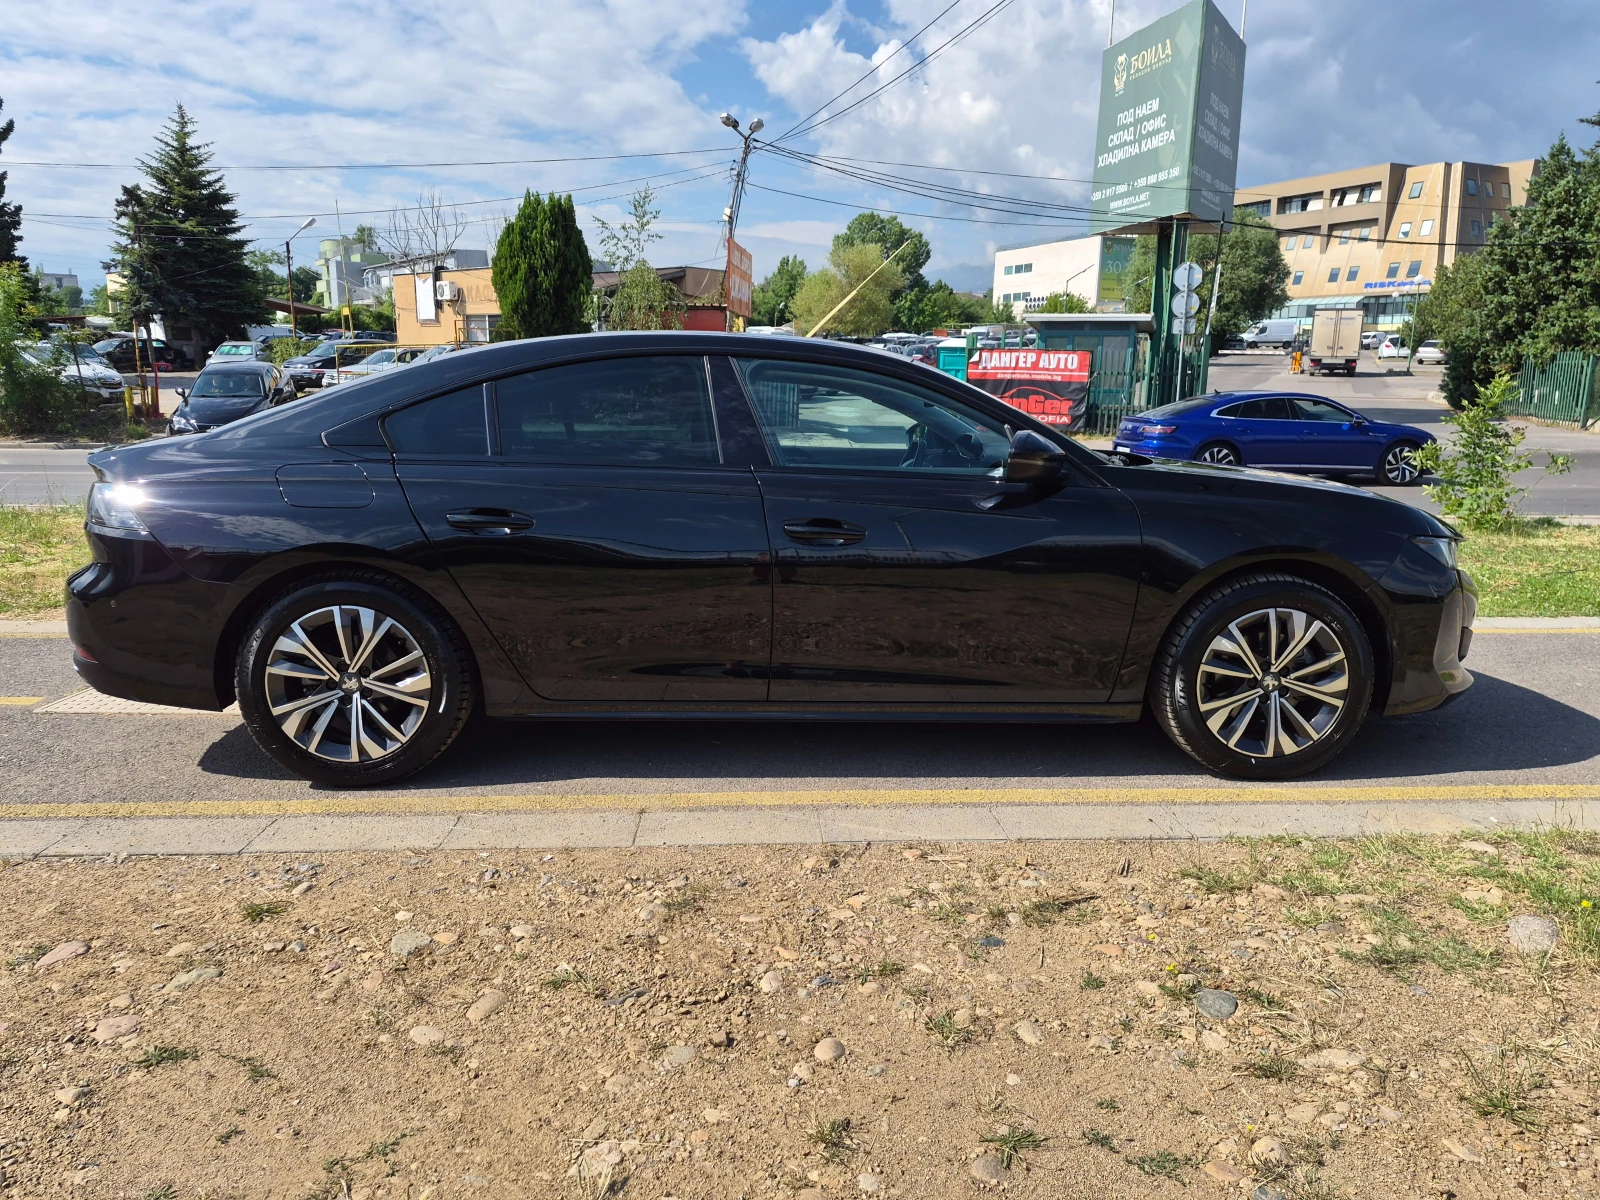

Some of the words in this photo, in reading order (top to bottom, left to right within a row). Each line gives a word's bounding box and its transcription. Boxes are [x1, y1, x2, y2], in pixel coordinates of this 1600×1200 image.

[1130, 38, 1172, 74] БОИЛА
[1117, 108, 1134, 126] ПОД
[1135, 97, 1160, 119] НАЕМ
[1108, 126, 1134, 148] СКЛАД
[1135, 124, 1141, 139] /
[1141, 113, 1167, 135] ОФИС
[1097, 142, 1140, 168] ХЛАДИЛНА
[1141, 128, 1176, 153] КАМЕРА
[1102, 189, 1106, 199] 2
[1106, 186, 1116, 197] 917
[1129, 180, 1133, 191] /
[1133, 176, 1147, 188] +359
[1169, 166, 1180, 178] 350
[1105, 260, 1122, 274] 30
[1363, 281, 1397, 289] RISK
[978, 351, 1037, 370] ДАНГЕР
[1038, 352, 1079, 370] АУТО
[996, 372, 1062, 381] dangerauto.mobile.bg
